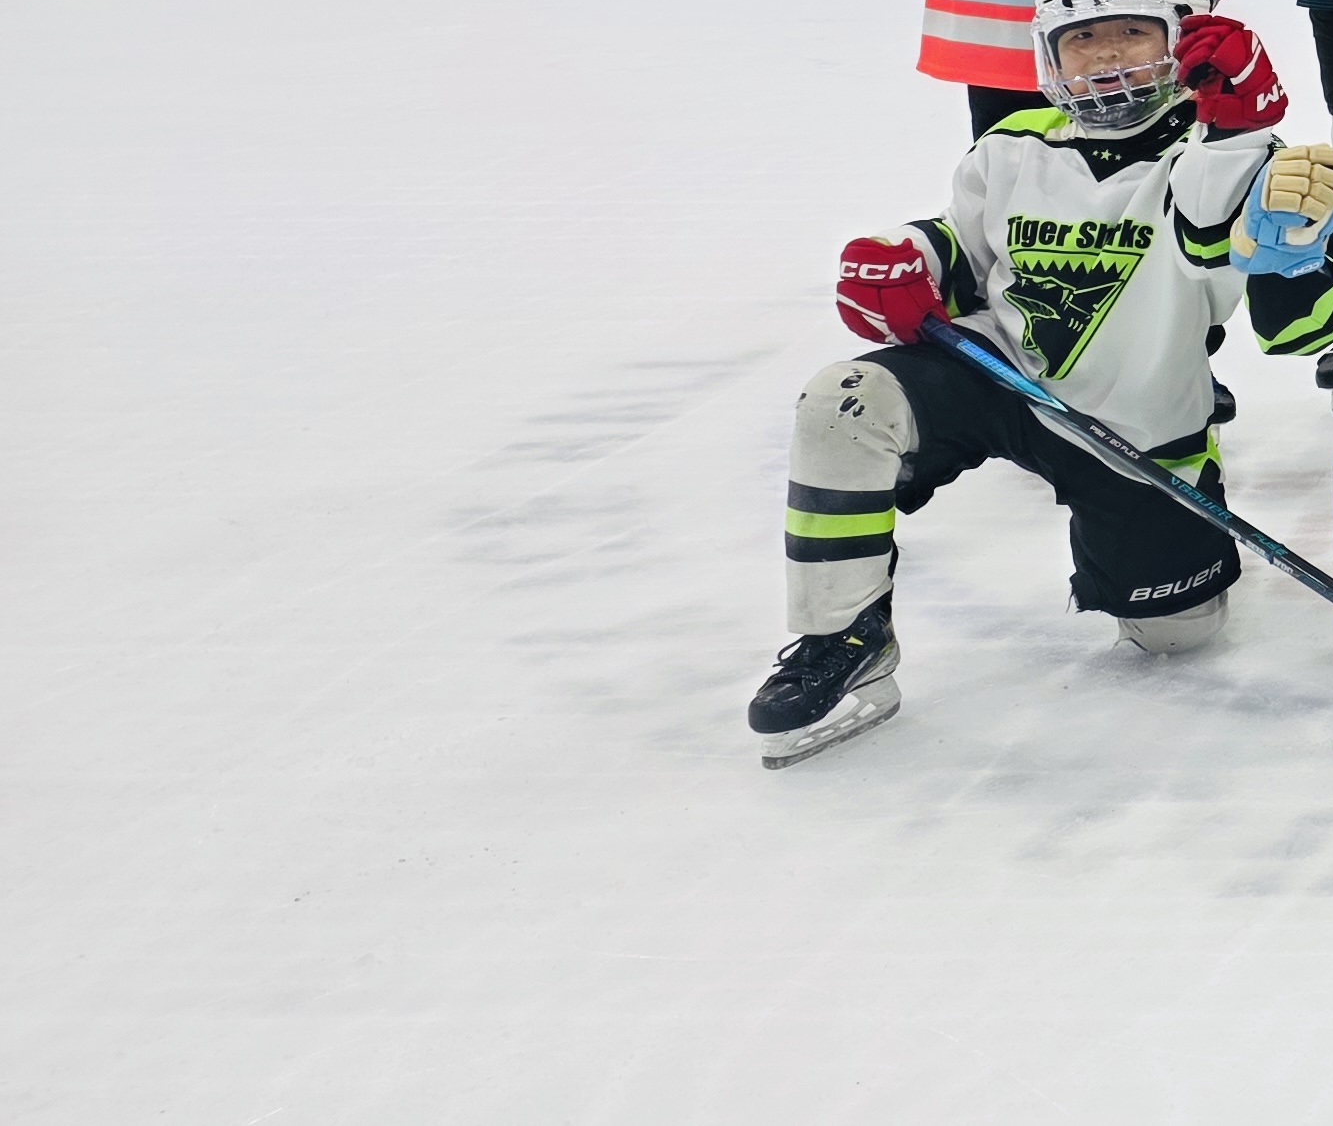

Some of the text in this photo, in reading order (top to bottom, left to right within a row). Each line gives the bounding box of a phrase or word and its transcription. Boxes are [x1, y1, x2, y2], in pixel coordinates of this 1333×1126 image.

[1006, 217, 1067, 250] Tiger
[840, 260, 923, 280] CCM
[1177, 483, 1234, 523] BAUER
[1129, 560, 1223, 603] BAUER
